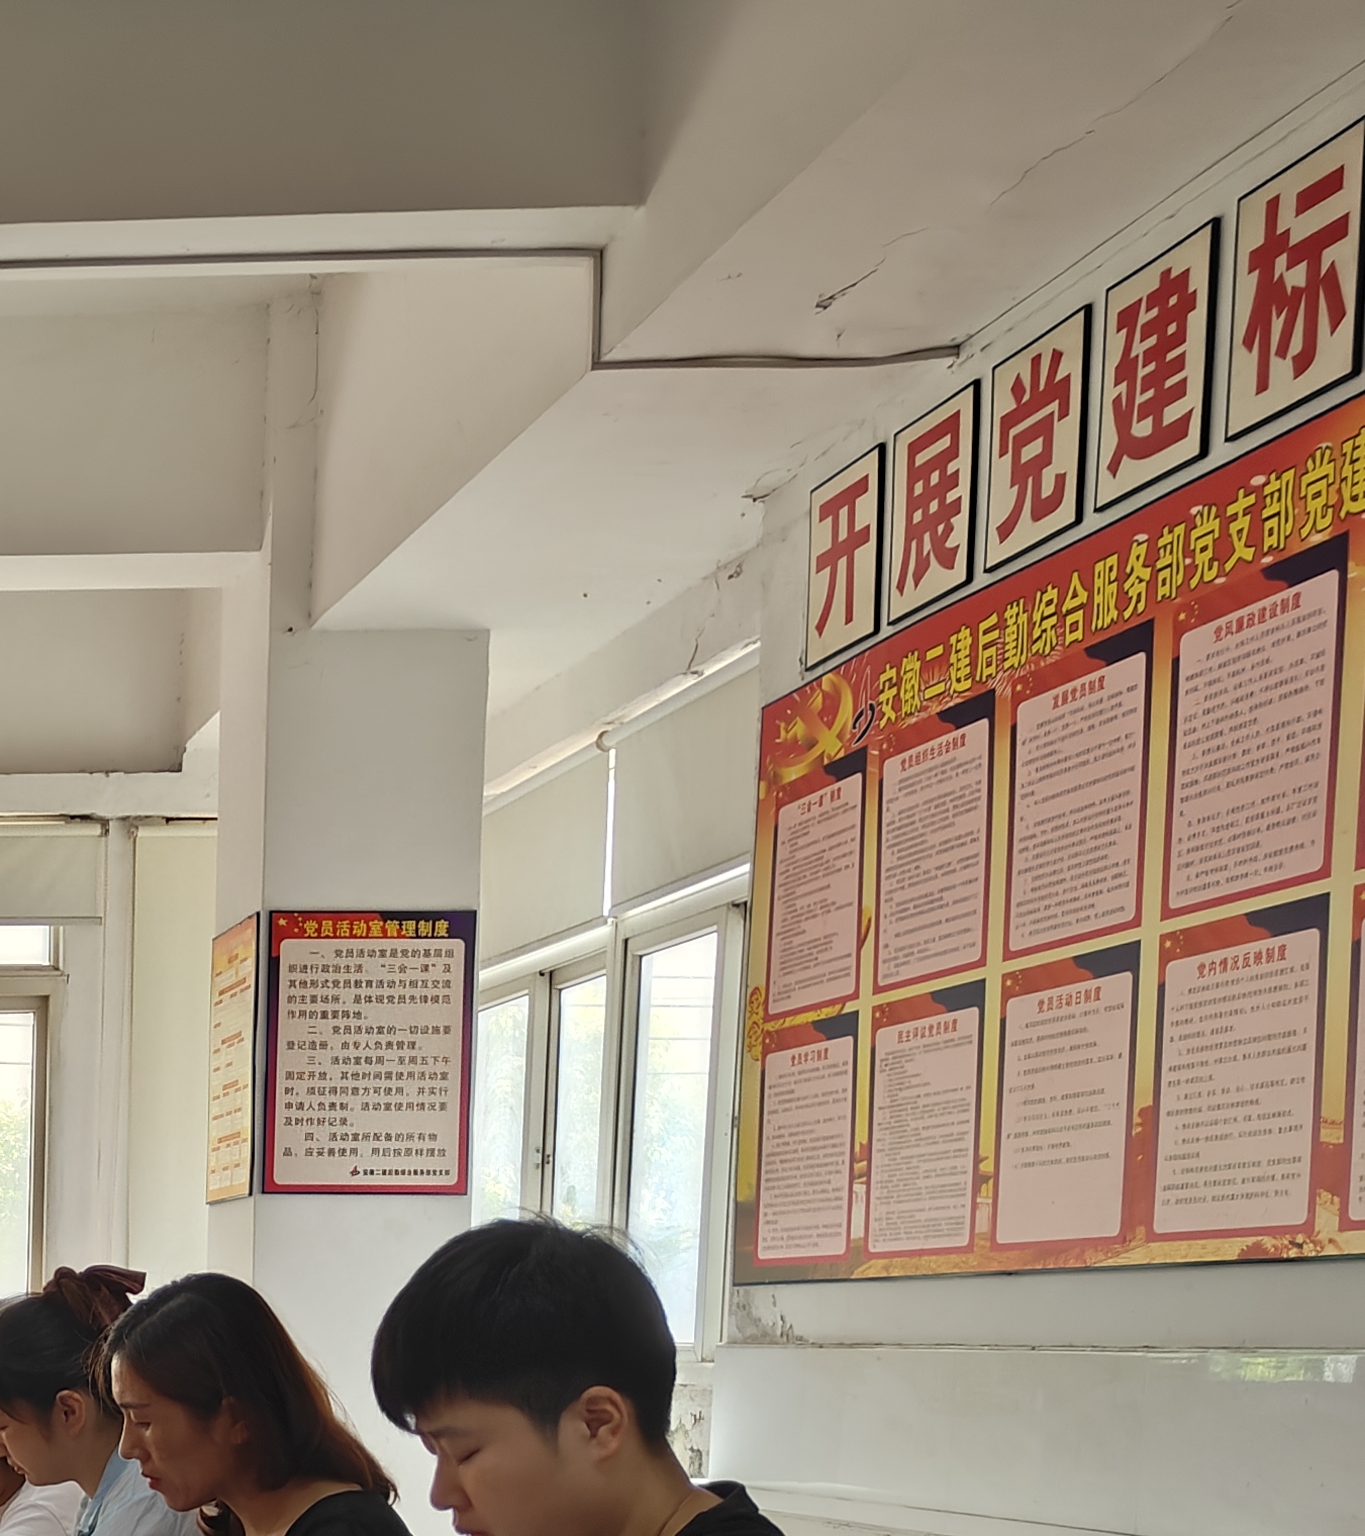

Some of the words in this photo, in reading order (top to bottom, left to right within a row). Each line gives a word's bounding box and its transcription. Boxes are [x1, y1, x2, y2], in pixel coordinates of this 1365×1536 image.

[1213, 591, 1302, 644] 党风廉政建设制度
[303, 919, 450, 938] 党员活动室管理制度
[1196, 943, 1288, 980] 党内情况反映制度
[1037, 985, 1102, 1015] 党员活动日制度
